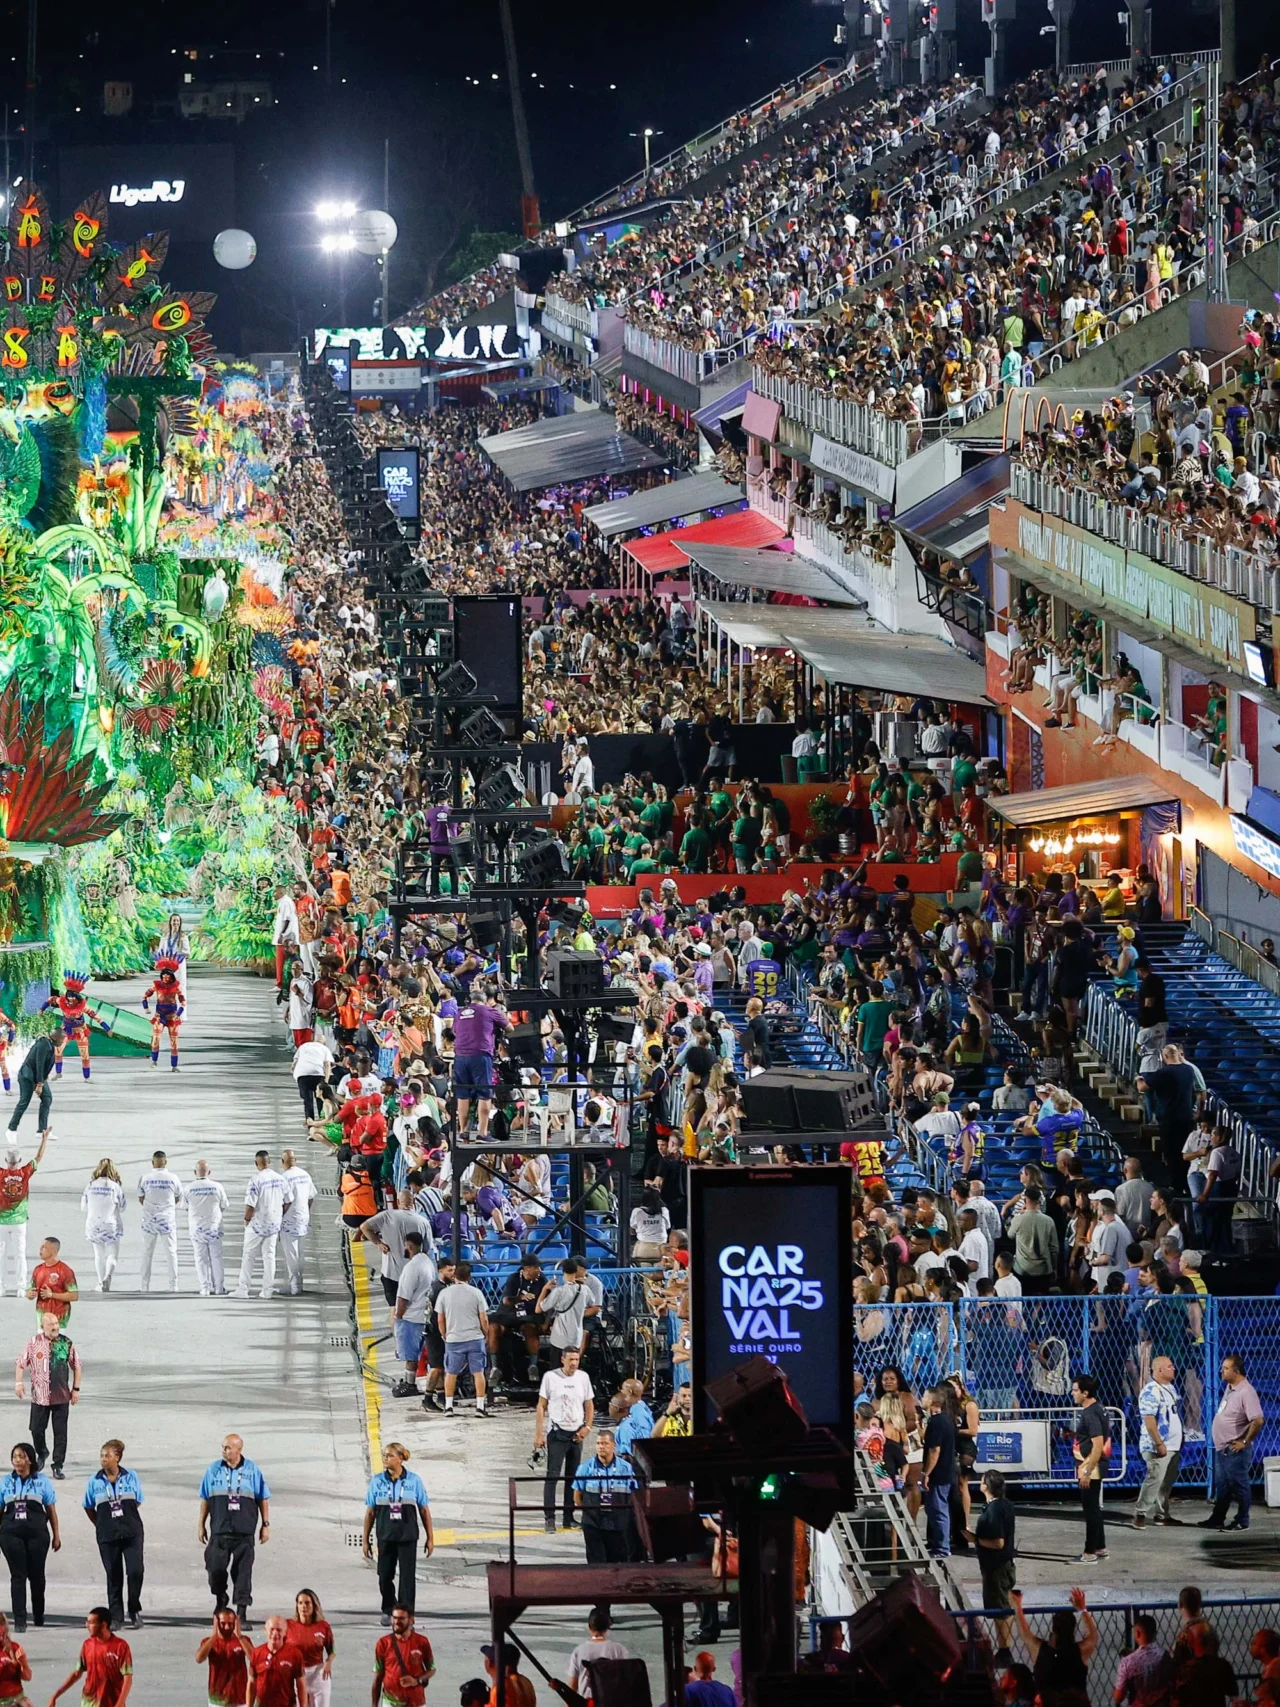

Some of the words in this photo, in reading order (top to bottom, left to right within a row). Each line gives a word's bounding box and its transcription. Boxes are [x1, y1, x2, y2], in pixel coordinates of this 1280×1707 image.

[109, 180, 185, 206] LigaRJ
[4, 276, 56, 301] DE
[383, 467, 408, 476] CAR
[1209, 604, 1240, 660] SAPUCAÍ
[754, 972, 778, 985] 20
[855, 1141, 880, 1160] 20
[858, 1159, 884, 1176] 25
[719, 1245, 803, 1276] CAR
[723, 1309, 800, 1339] VAL
[729, 1343, 764, 1353] SÉRIE
[769, 1344, 802, 1352] OURO
[997, 1435, 1012, 1444] Rio
